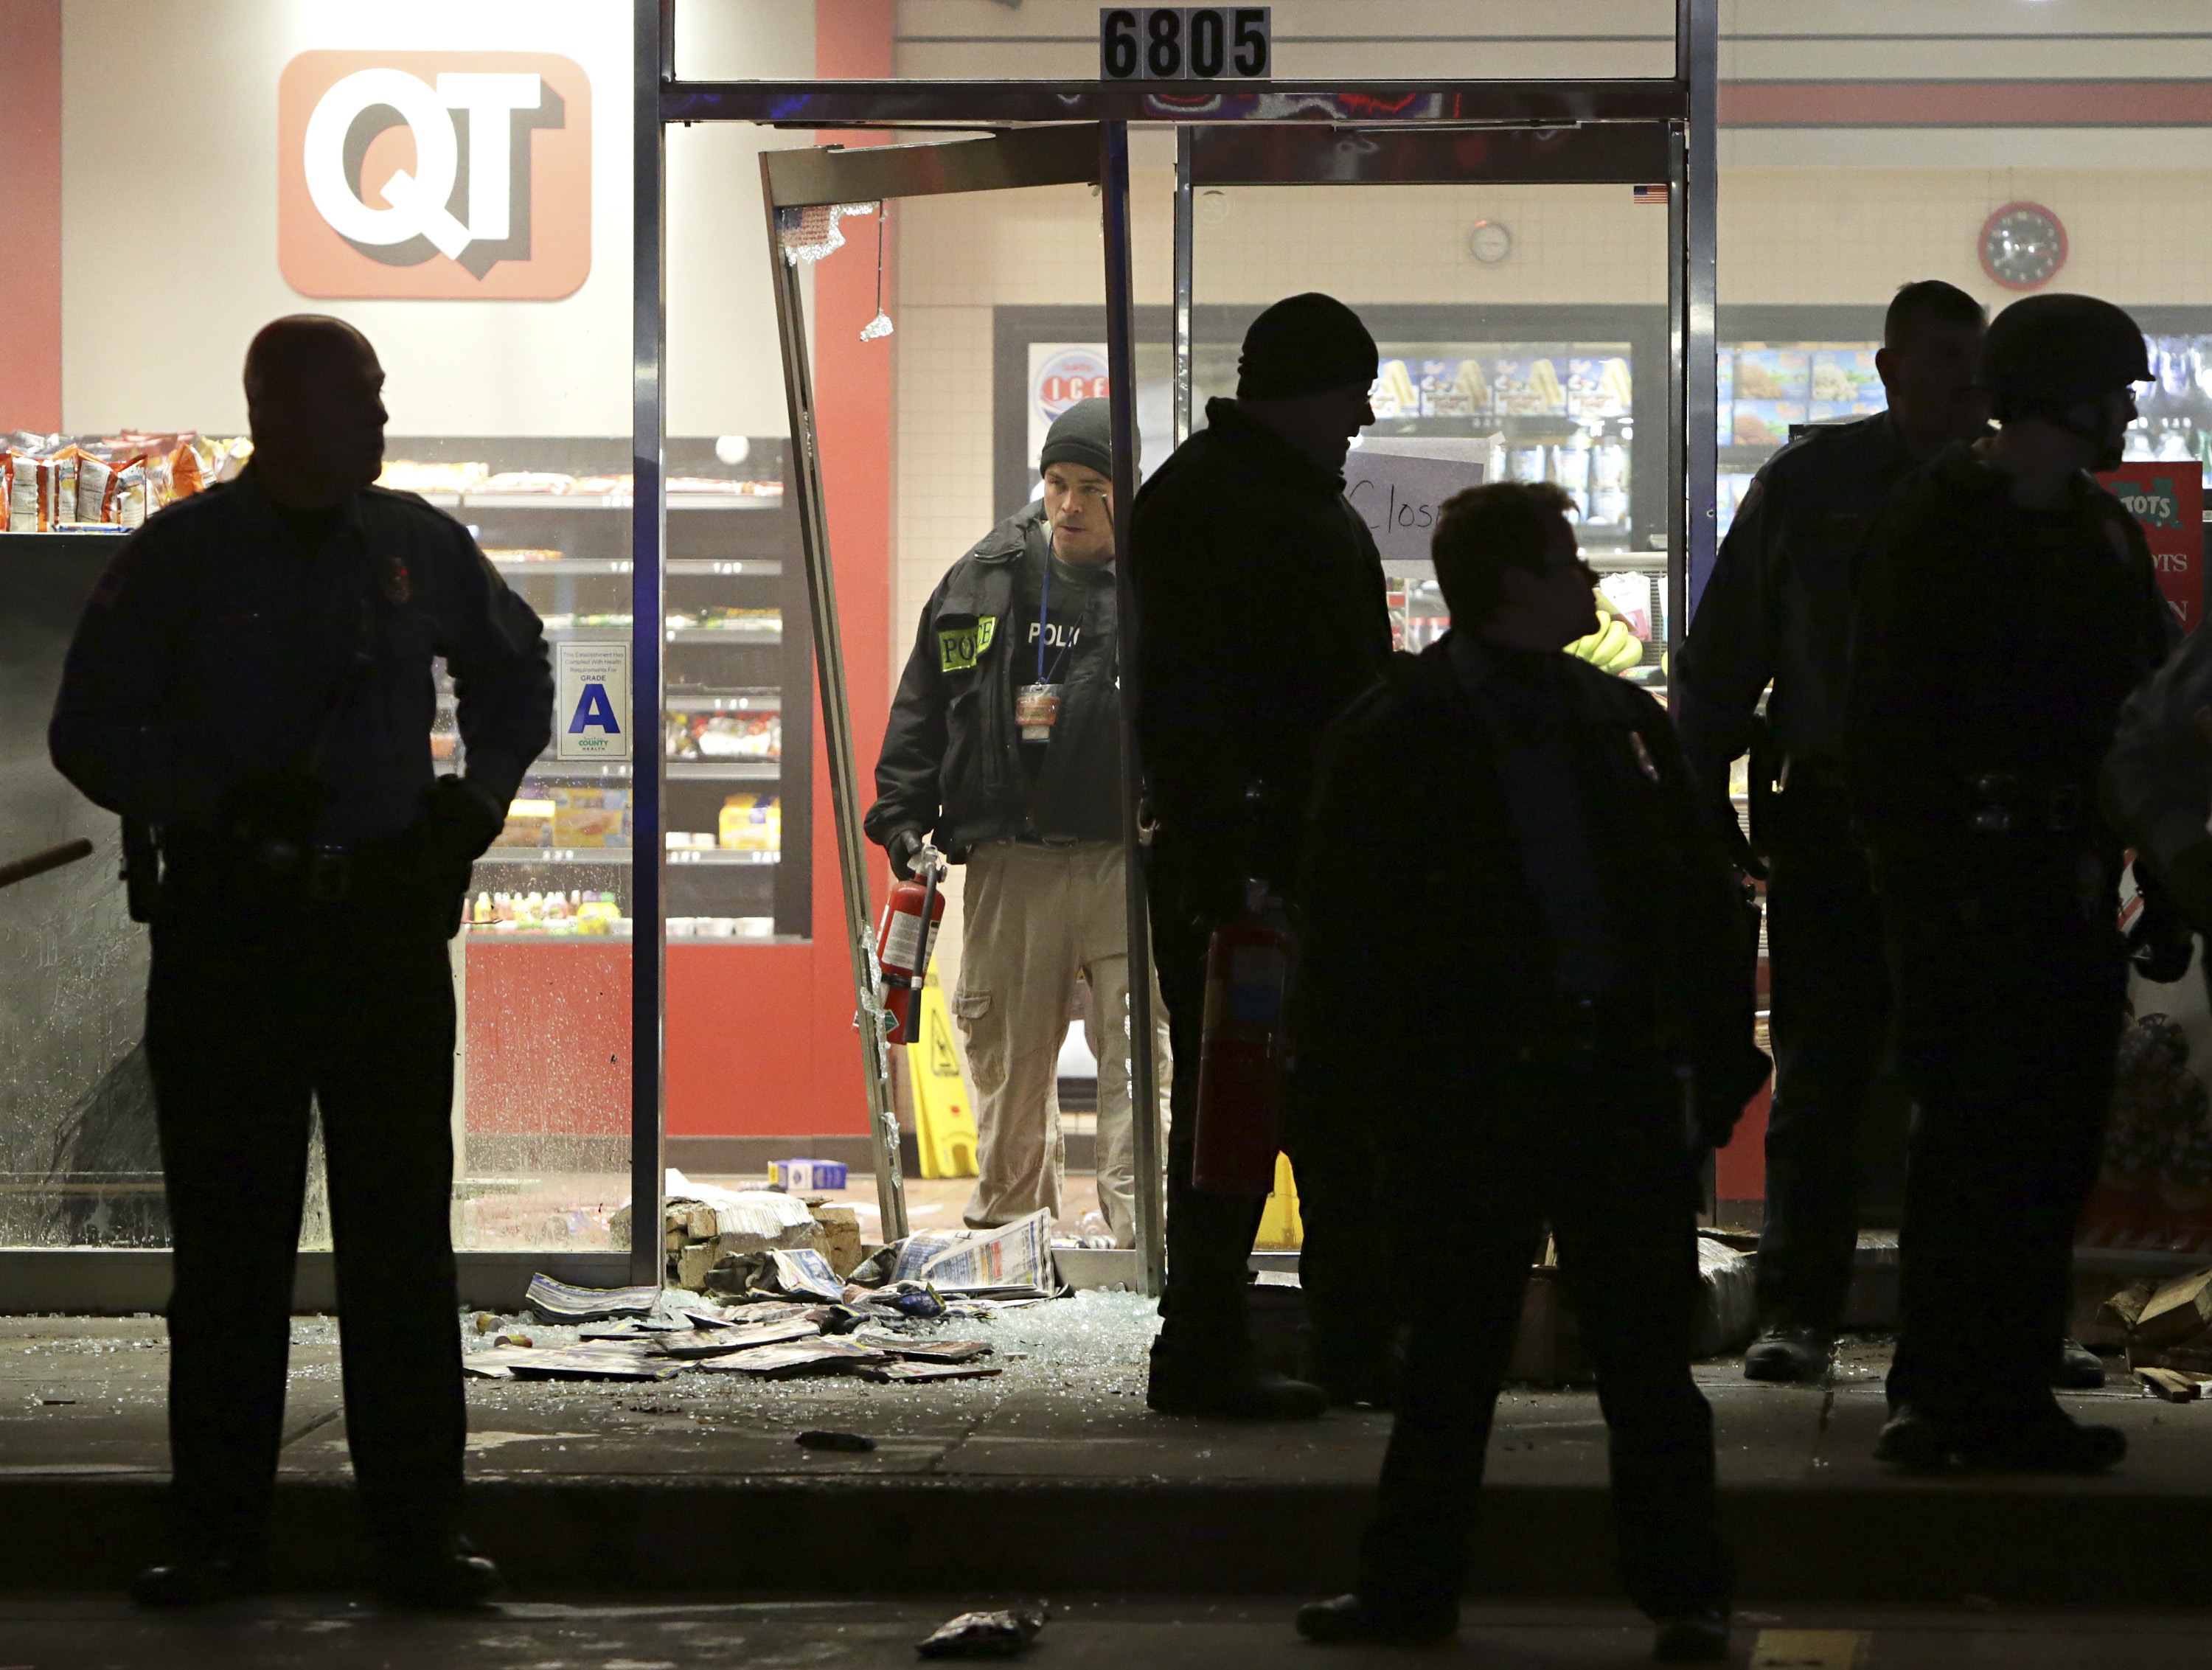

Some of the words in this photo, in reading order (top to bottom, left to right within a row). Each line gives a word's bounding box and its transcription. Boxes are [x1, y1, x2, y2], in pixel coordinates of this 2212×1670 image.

[1105, 9, 1266, 78] 6805
[304, 68, 540, 260] QT
[1349, 481, 1441, 532] Clos
[2121, 495, 2171, 518] TOTS
[568, 683, 621, 734] A
